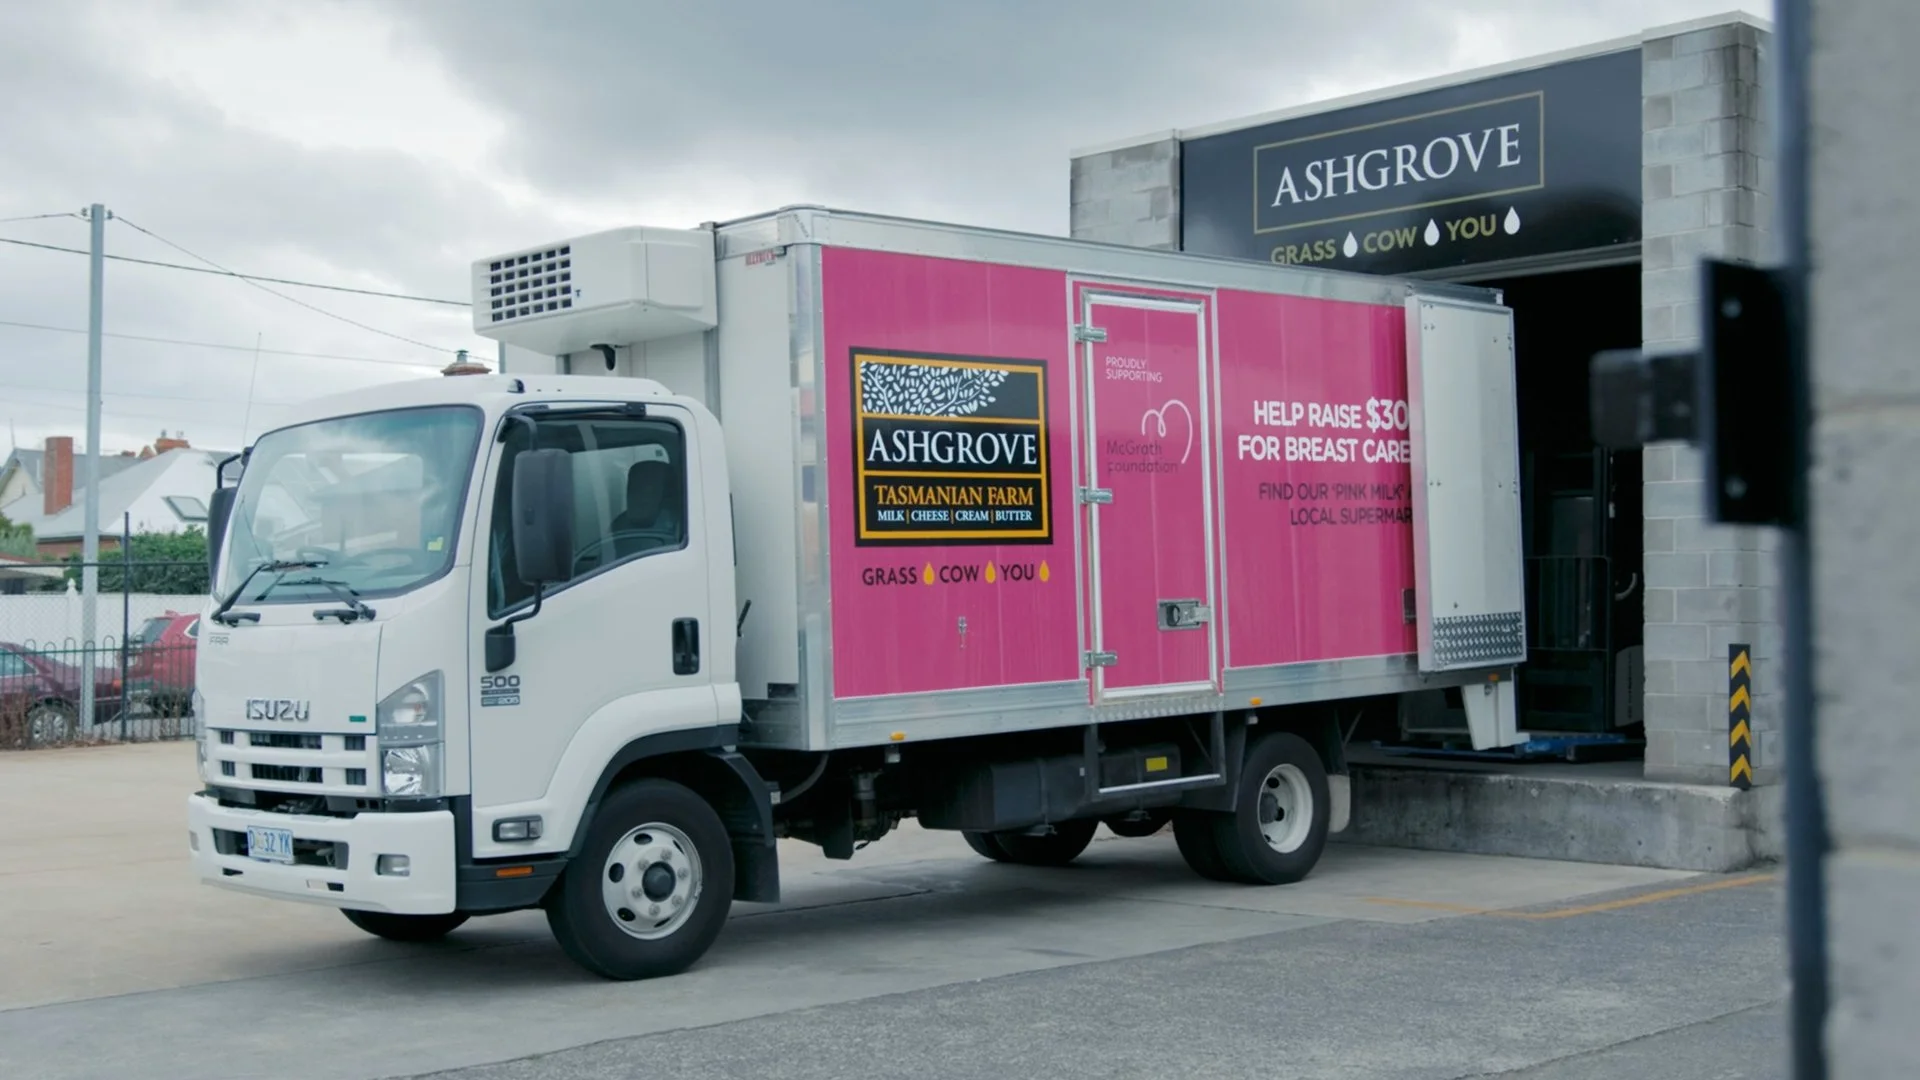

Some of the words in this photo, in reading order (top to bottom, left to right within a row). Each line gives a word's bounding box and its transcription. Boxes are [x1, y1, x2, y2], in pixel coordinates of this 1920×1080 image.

[1271, 123, 1521, 208] ASHGROVE
[1271, 239, 1337, 265] GRASS
[1363, 226, 1417, 254] COW
[1446, 214, 1497, 241] YOU
[1106, 356, 1147, 370] PROUDLY
[1106, 368, 1163, 383] SUPPORTING
[1254, 400, 1304, 427] HELP
[1308, 403, 1362, 429] RAISE
[867, 429, 1037, 465] ASHGROVE
[1106, 440, 1162, 456] McGrath
[1238, 435, 1280, 461] FOR
[1285, 437, 1358, 463] BREAST
[1362, 439, 1411, 463] CARE
[1107, 460, 1178, 475] foundation
[874, 485, 982, 506] TASMANIAN
[987, 488, 1034, 506] FARM
[1259, 483, 1294, 500] FIND
[1297, 483, 1329, 500] OUR
[877, 510, 905, 522] MILK
[911, 510, 950, 522] CHEESE
[955, 510, 989, 522] CREAM
[995, 510, 1033, 522] BUTTER
[1290, 507, 1337, 526] LOCAL
[862, 567, 918, 586] GRASS
[939, 565, 980, 584] COW
[1000, 564, 1035, 582] YOU
[480, 675, 521, 689] 500
[246, 699, 310, 721] ISUZU
